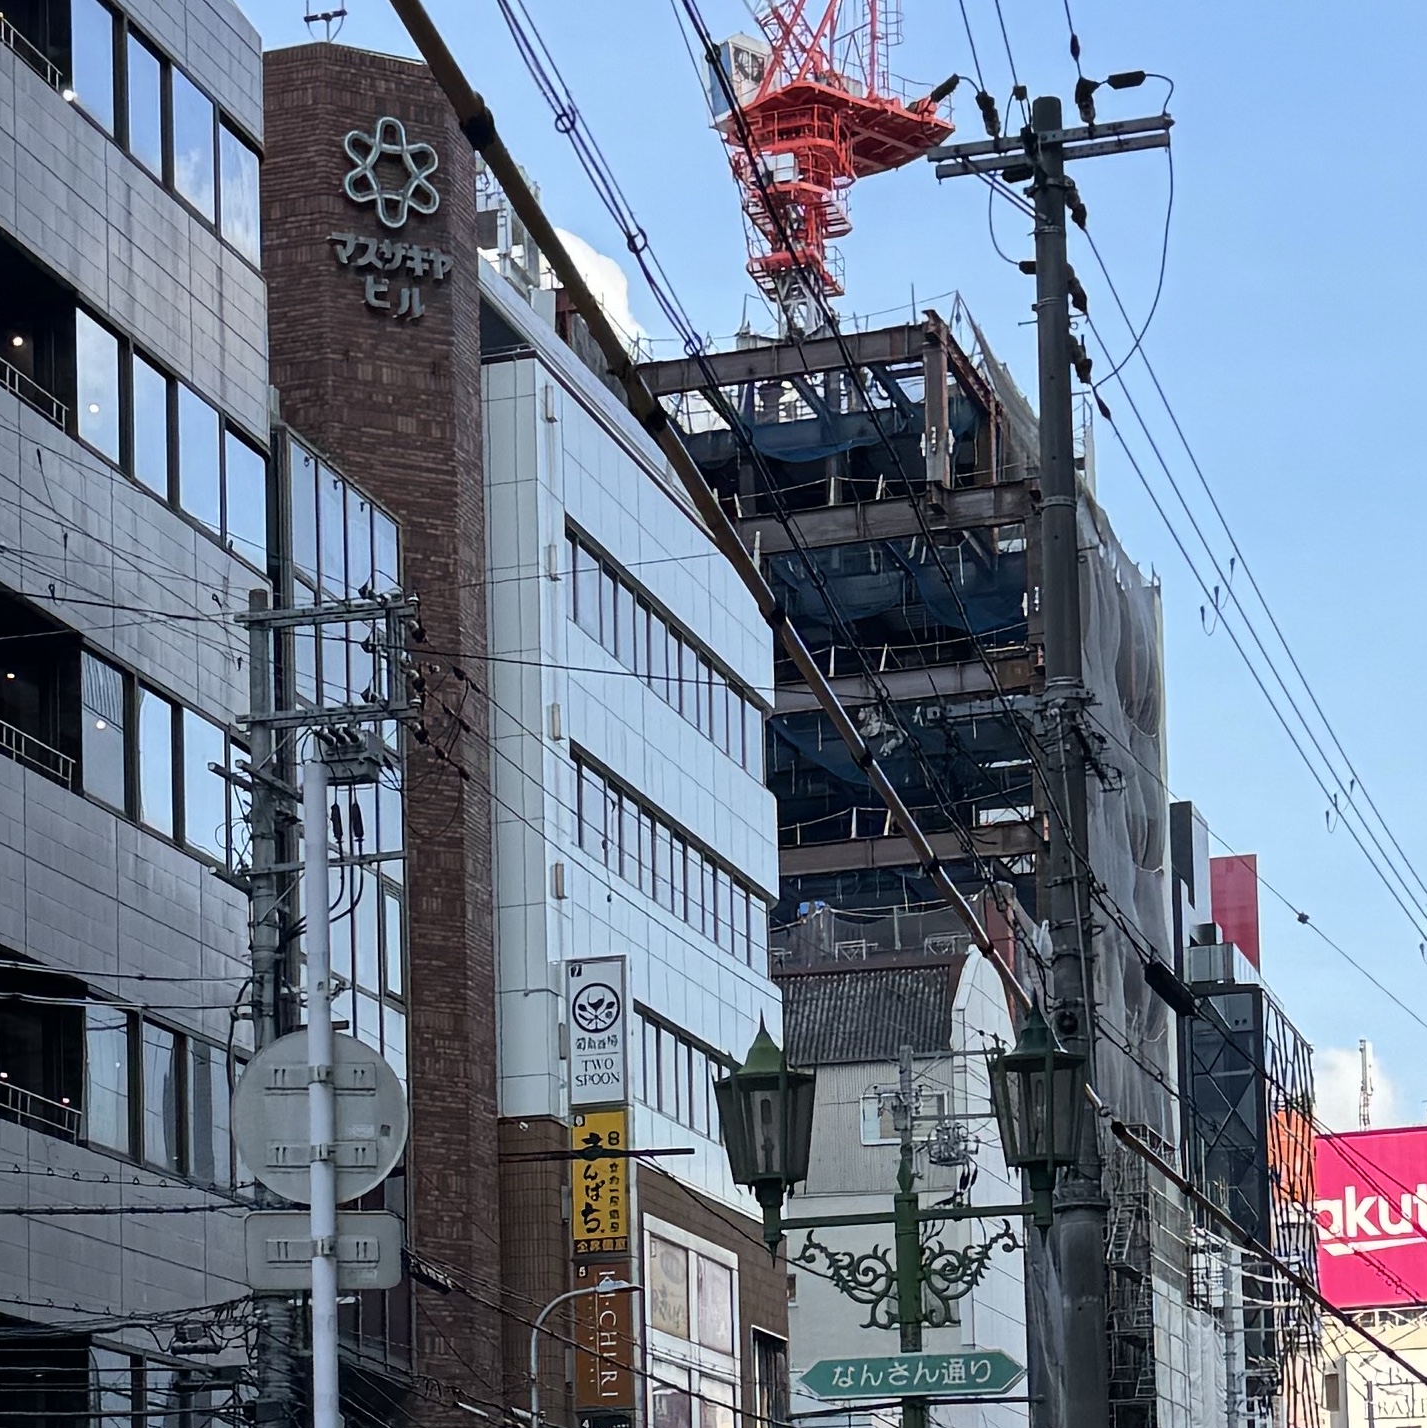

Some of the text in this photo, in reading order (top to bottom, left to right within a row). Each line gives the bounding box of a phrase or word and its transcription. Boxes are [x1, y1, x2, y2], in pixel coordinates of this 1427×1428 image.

[326, 231, 454, 279] マスザキヤ
[360, 275, 425, 320] ビル
[581, 1058, 614, 1072] TWO
[575, 1073, 620, 1087] SPOON
[831, 1358, 992, 1387] なんさん通り
